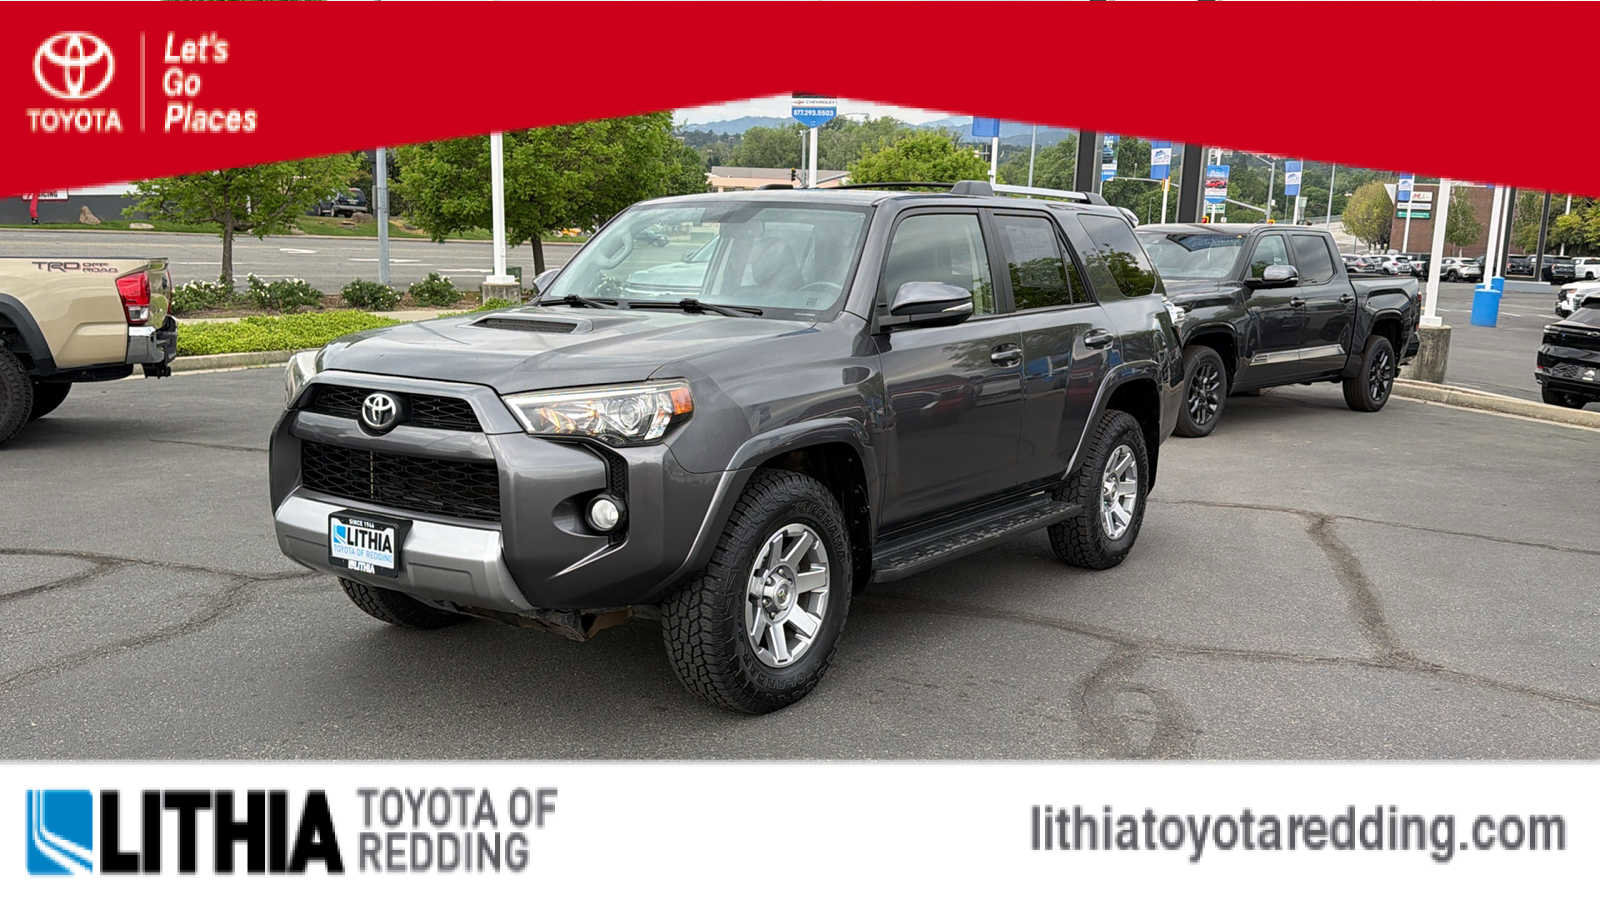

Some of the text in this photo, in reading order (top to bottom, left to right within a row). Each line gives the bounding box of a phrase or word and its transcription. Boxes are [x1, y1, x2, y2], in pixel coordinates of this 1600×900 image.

[32, 261, 81, 273] TRD
[347, 526, 393, 553] LITHIA
[333, 543, 355, 554] TOYOTA
[356, 547, 365, 557] OF
